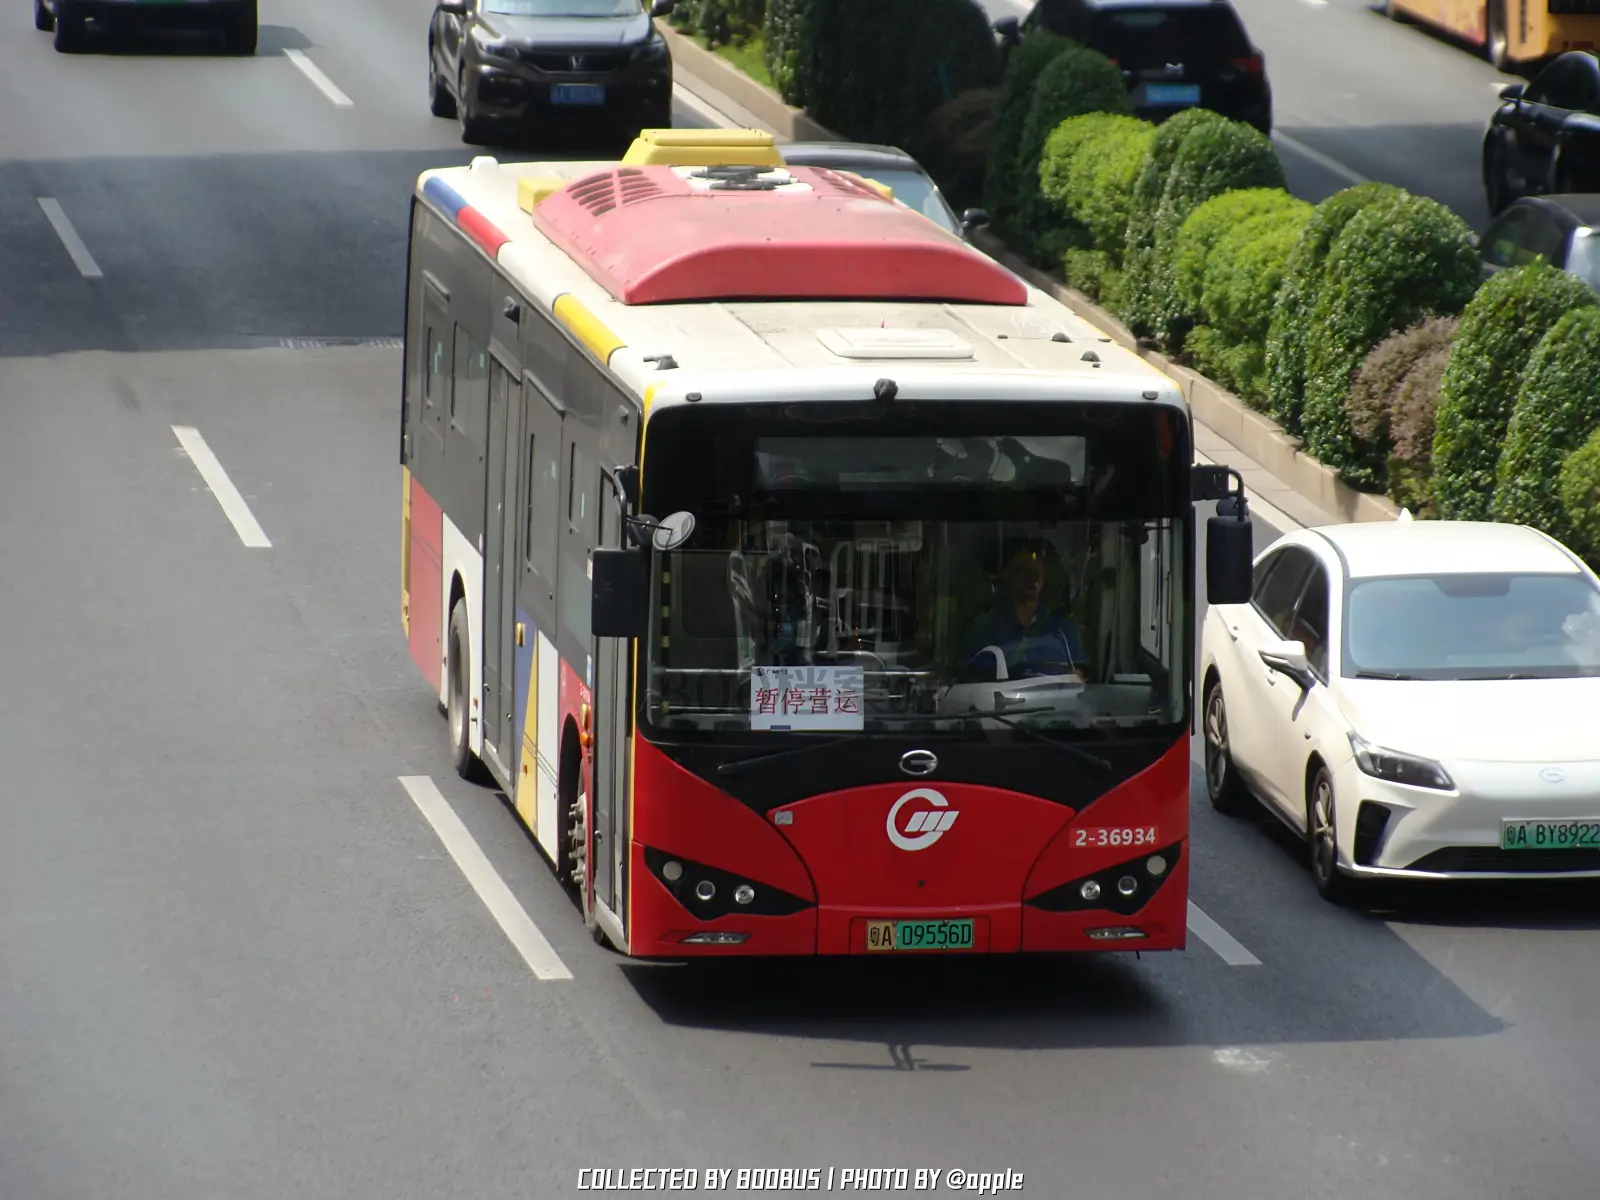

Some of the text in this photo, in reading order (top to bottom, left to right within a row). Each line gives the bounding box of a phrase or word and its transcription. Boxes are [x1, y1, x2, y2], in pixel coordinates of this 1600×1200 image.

[755, 687, 859, 715] 暂停营运
[1075, 827, 1156, 846] 2-36934
[1506, 823, 1600, 845] 粤A BY8922
[869, 923, 972, 946] 粤A 09556D
